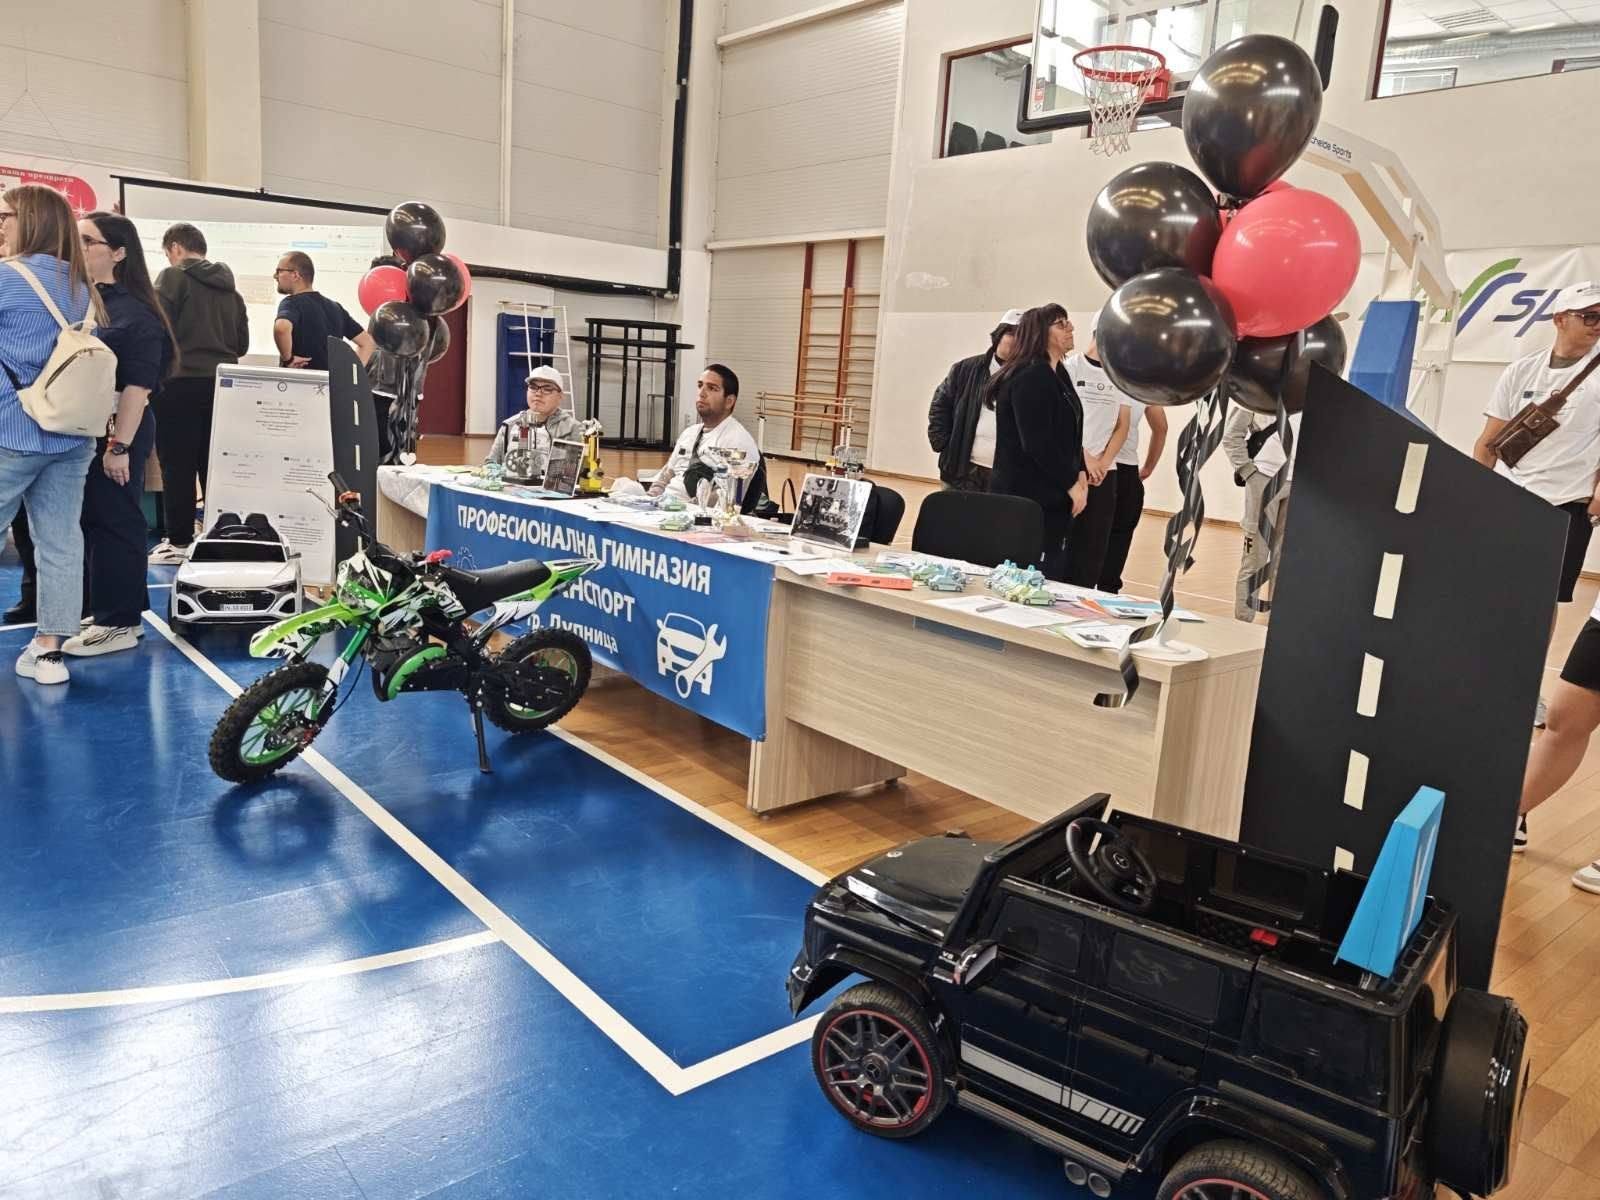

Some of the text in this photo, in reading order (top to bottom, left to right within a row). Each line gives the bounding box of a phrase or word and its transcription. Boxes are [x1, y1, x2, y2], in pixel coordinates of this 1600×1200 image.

[457, 505, 712, 596] ПРОФЕСИОНАЛНА ГИМНАЗИЯ
[563, 577, 635, 623] НСПОРТ
